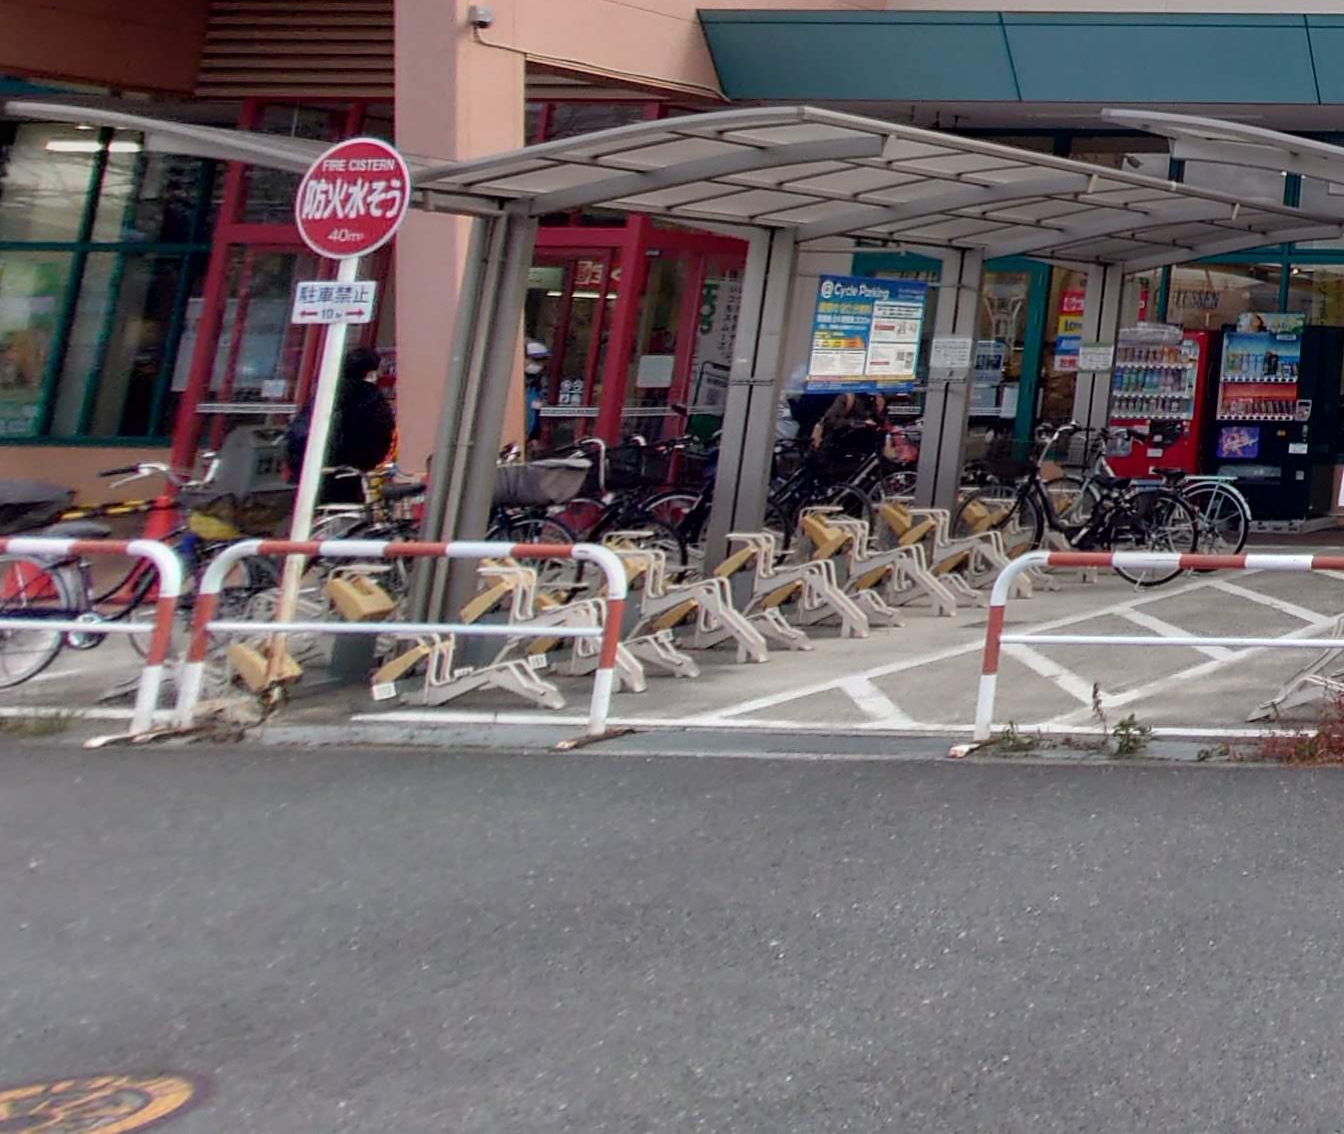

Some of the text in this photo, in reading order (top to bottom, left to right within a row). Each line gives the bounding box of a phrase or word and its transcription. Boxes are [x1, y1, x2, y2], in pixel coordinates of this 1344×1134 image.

[322, 159, 395, 172] FIRE CISTERN
[302, 178, 402, 220] 防火水そう
[299, 286, 369, 304] 駐車禁止
